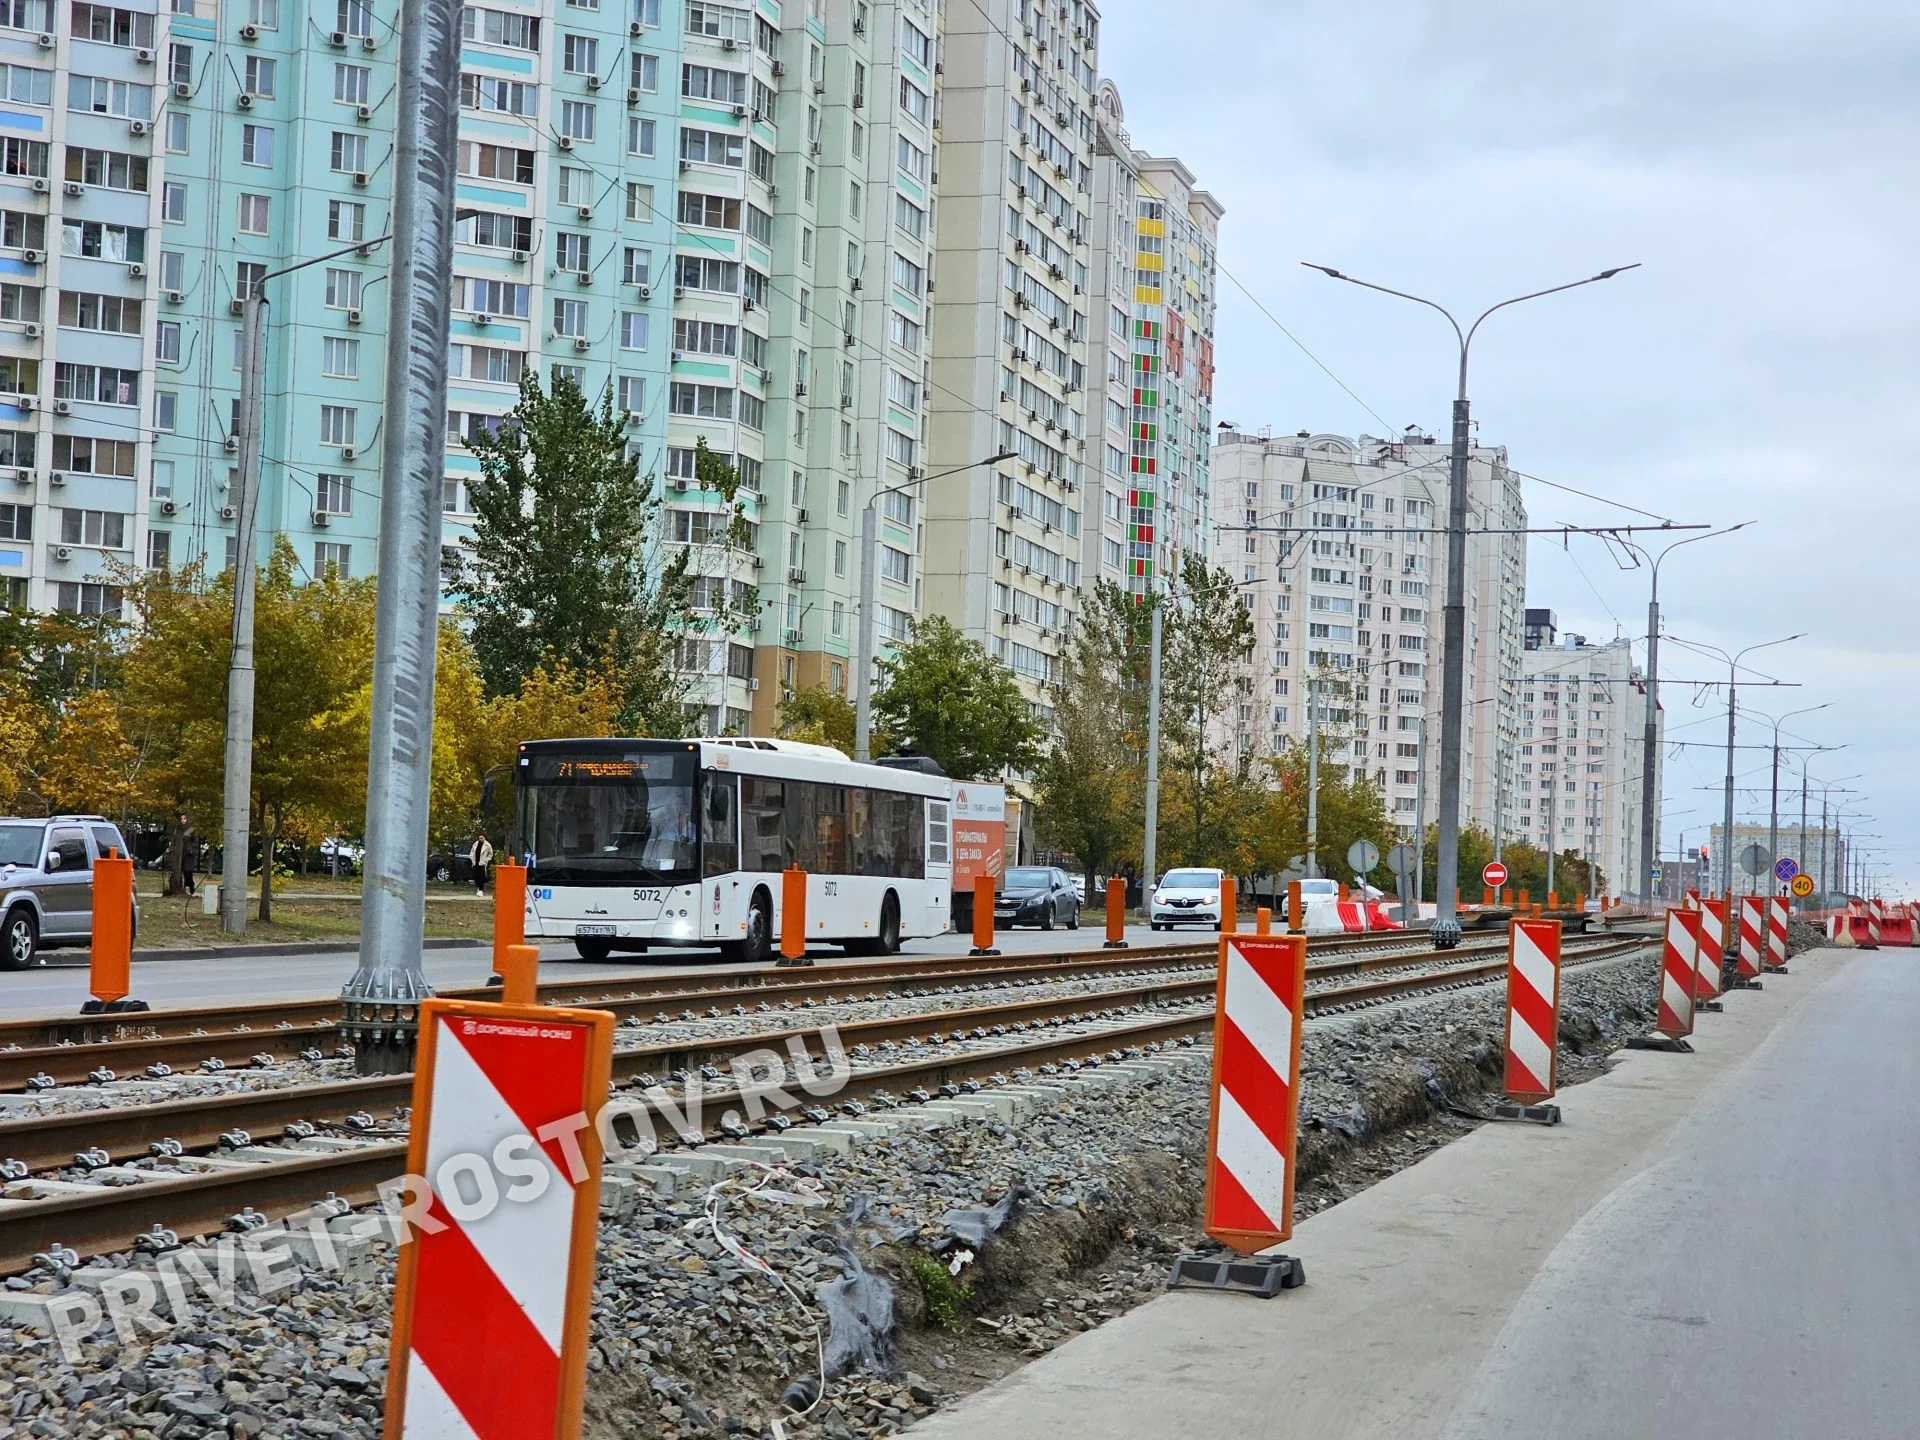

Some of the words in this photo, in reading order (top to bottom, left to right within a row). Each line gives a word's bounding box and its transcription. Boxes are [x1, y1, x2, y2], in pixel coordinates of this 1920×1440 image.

[557, 762, 572, 777] 71
[524, 853, 537, 868] 71
[825, 881, 837, 896] 5072
[1794, 880, 1810, 891] 40
[633, 889, 660, 901] 5072
[477, 1024, 538, 1036] ДОРОЖНЫЙ
[540, 1029, 572, 1040] ФОНД
